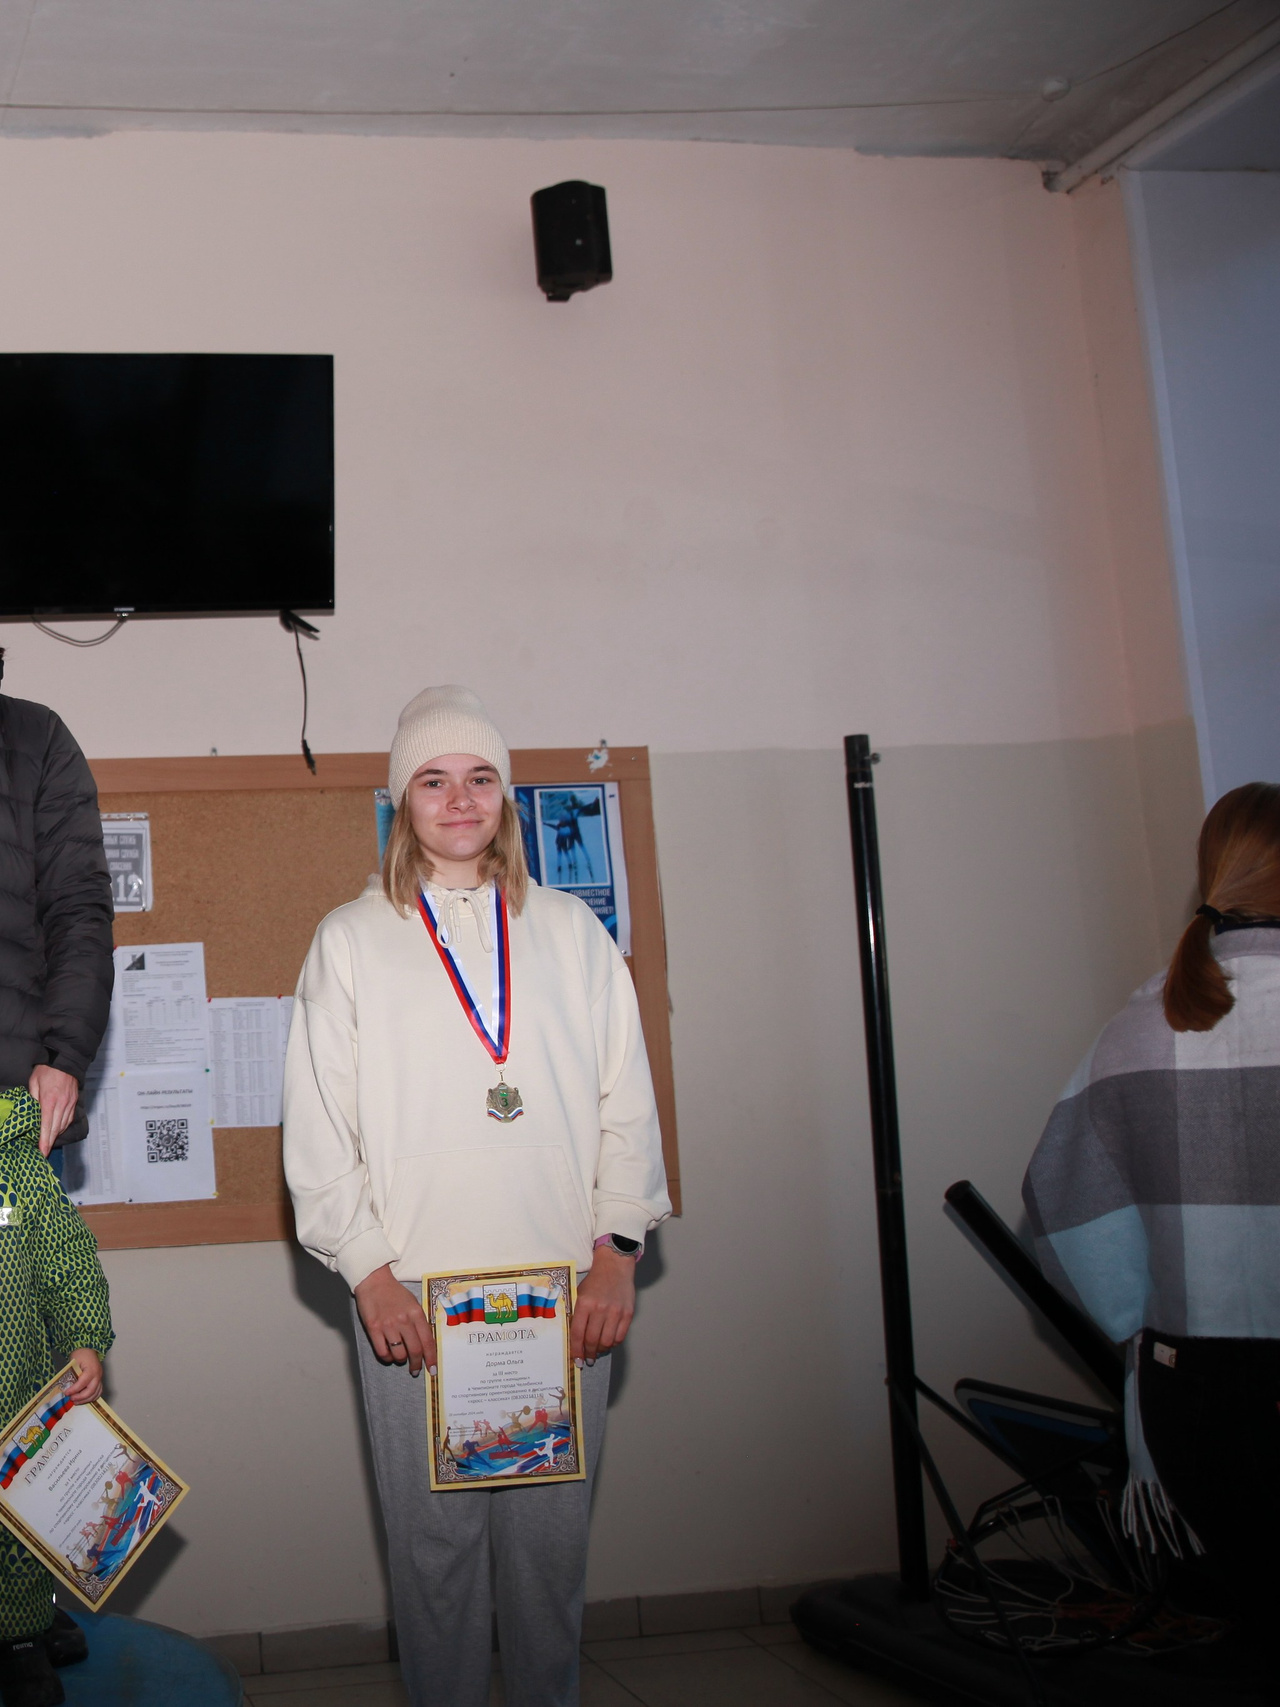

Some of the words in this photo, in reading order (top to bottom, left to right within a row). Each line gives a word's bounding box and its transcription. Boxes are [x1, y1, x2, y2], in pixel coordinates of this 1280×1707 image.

[111, 874, 142, 902] 12
[502, 1098, 509, 1107] 3
[468, 1328, 537, 1344] ГРАМОТА
[488, 1388, 528, 1396] ориентированию
[24, 1425, 72, 1484] ГРАМОТА
[48, 1465, 70, 1491] Васильева
[68, 1449, 82, 1466] Ирина
[12, 1641, 34, 1651] reima
